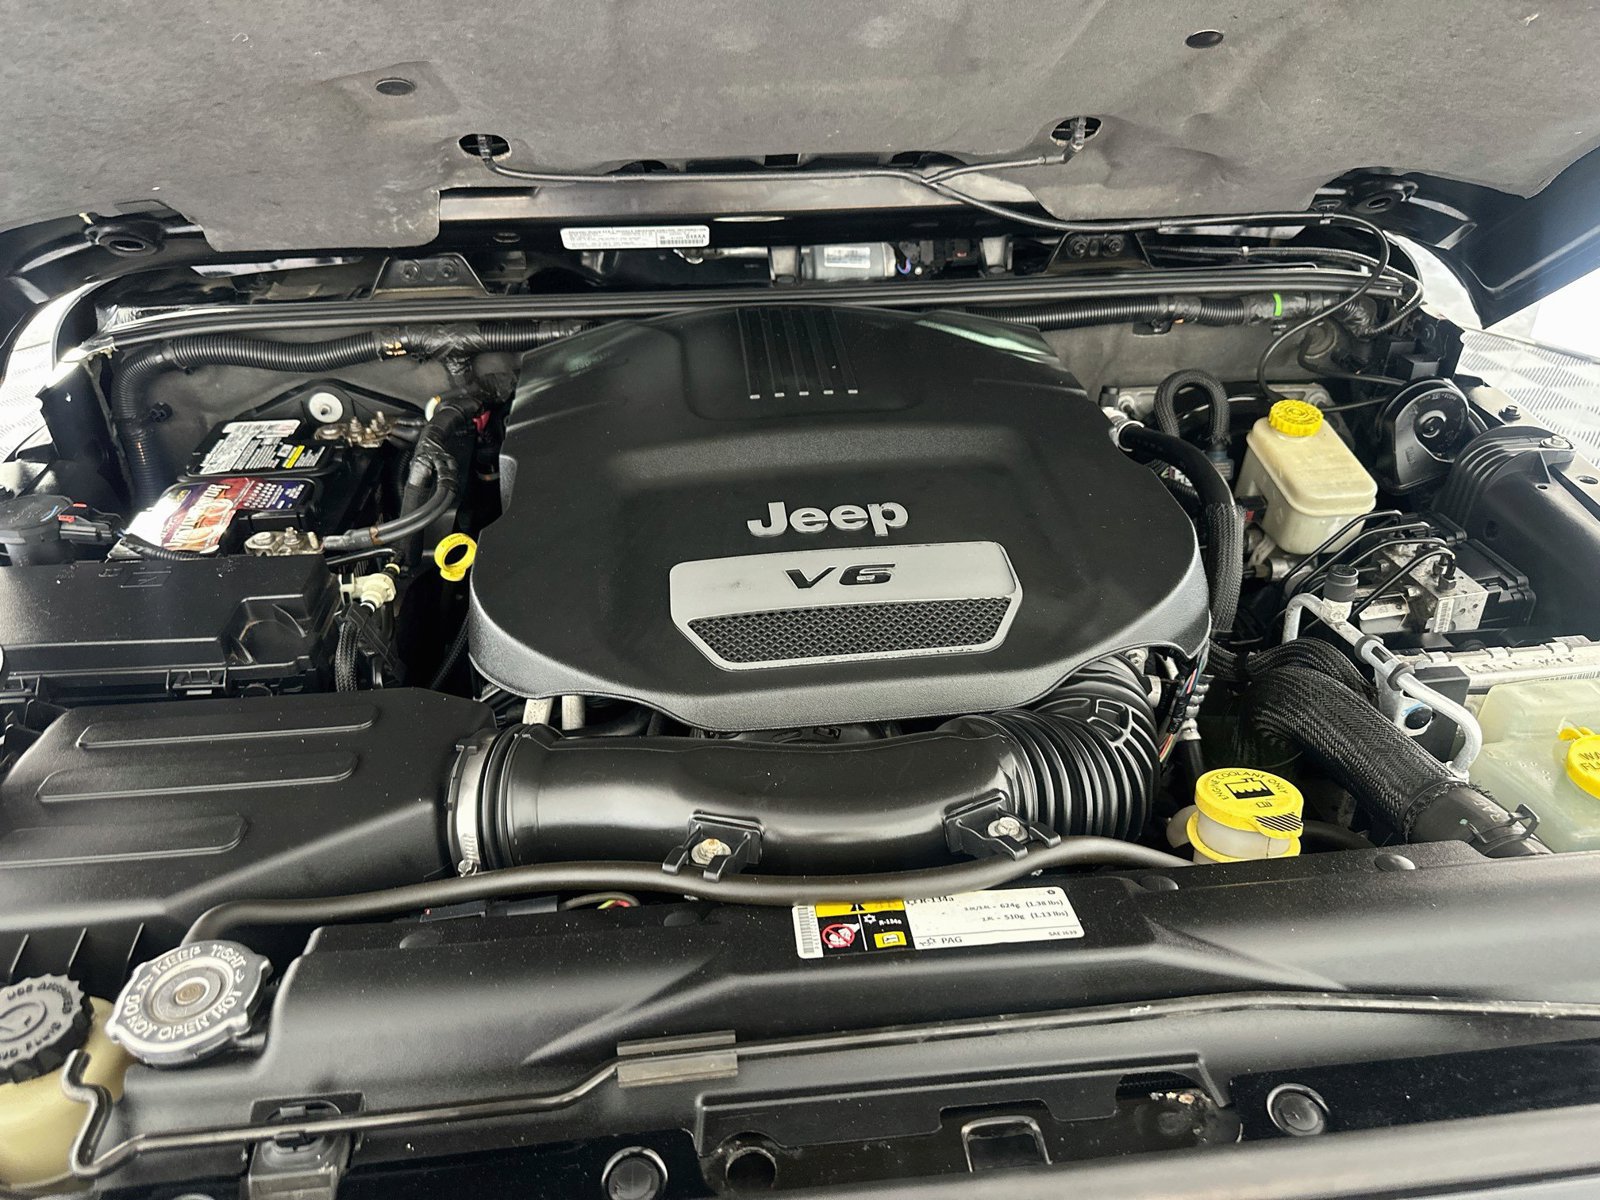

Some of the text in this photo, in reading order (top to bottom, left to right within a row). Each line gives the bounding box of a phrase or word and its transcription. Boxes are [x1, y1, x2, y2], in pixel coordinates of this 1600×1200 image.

[747, 501, 909, 537] Jeep
[784, 563, 896, 590] V6
[1216, 770, 1266, 781] COOLANT
[1267, 778, 1289, 794] ONLY
[941, 936, 963, 945] PAG
[151, 944, 247, 975] KEEP TIGHT
[124, 988, 243, 1041] DO NOT OPEN HOT
